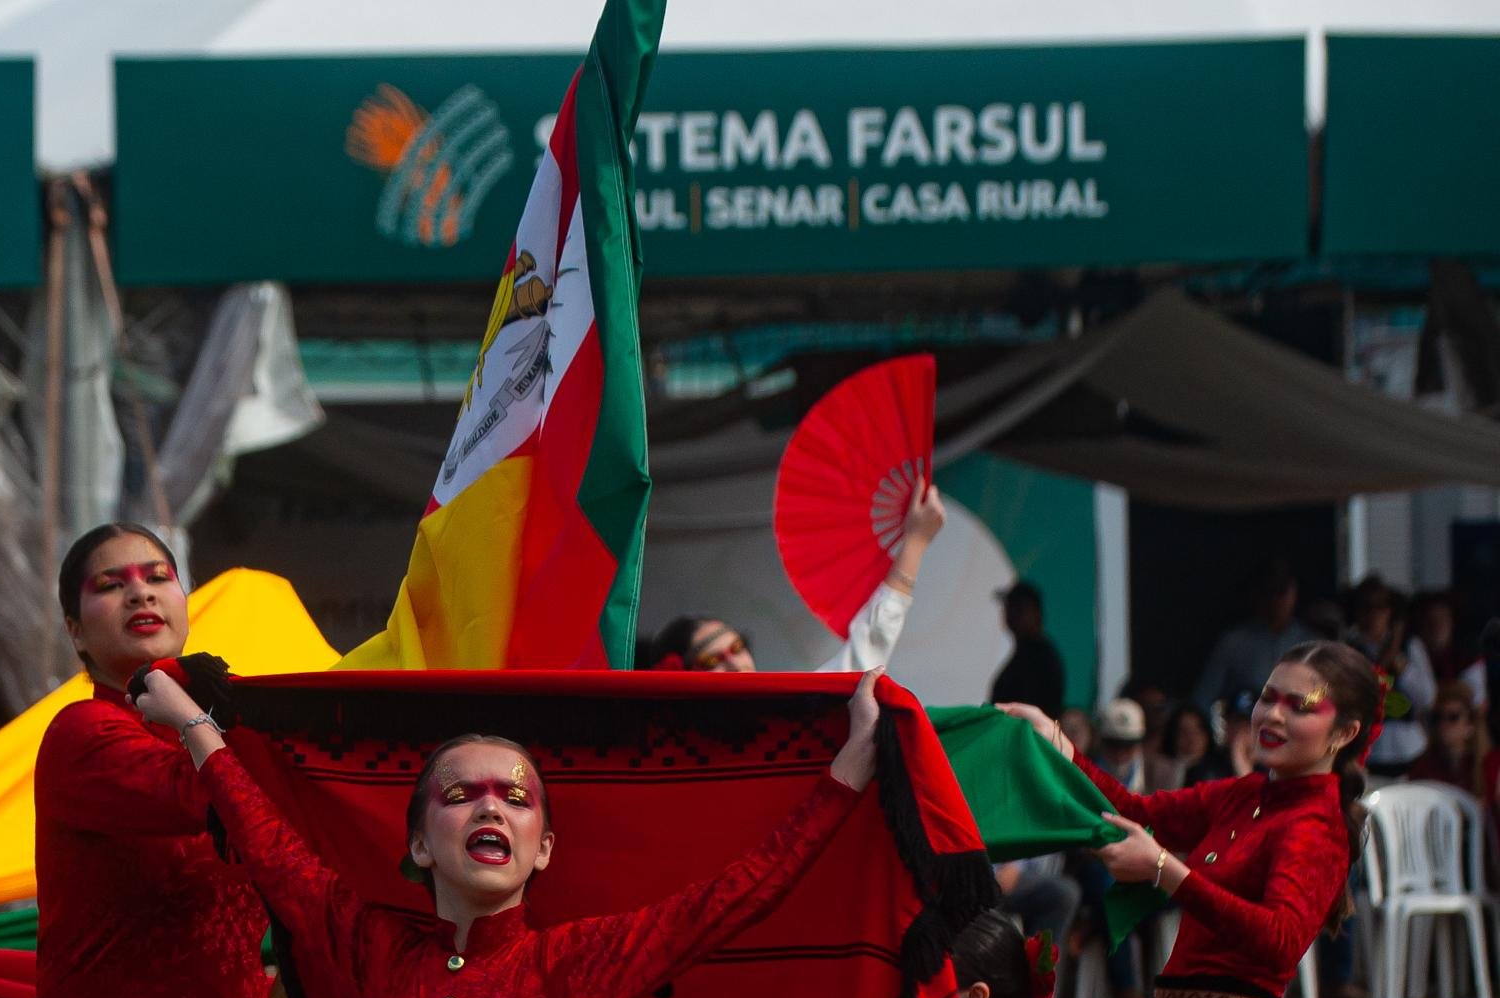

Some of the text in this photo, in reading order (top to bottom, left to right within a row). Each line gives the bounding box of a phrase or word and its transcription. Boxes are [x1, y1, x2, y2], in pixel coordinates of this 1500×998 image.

[847, 102, 1106, 167] FARSUL
[705, 184, 844, 228] SENAR
[861, 182, 971, 224] CASA
[976, 179, 1108, 220] RURAL
